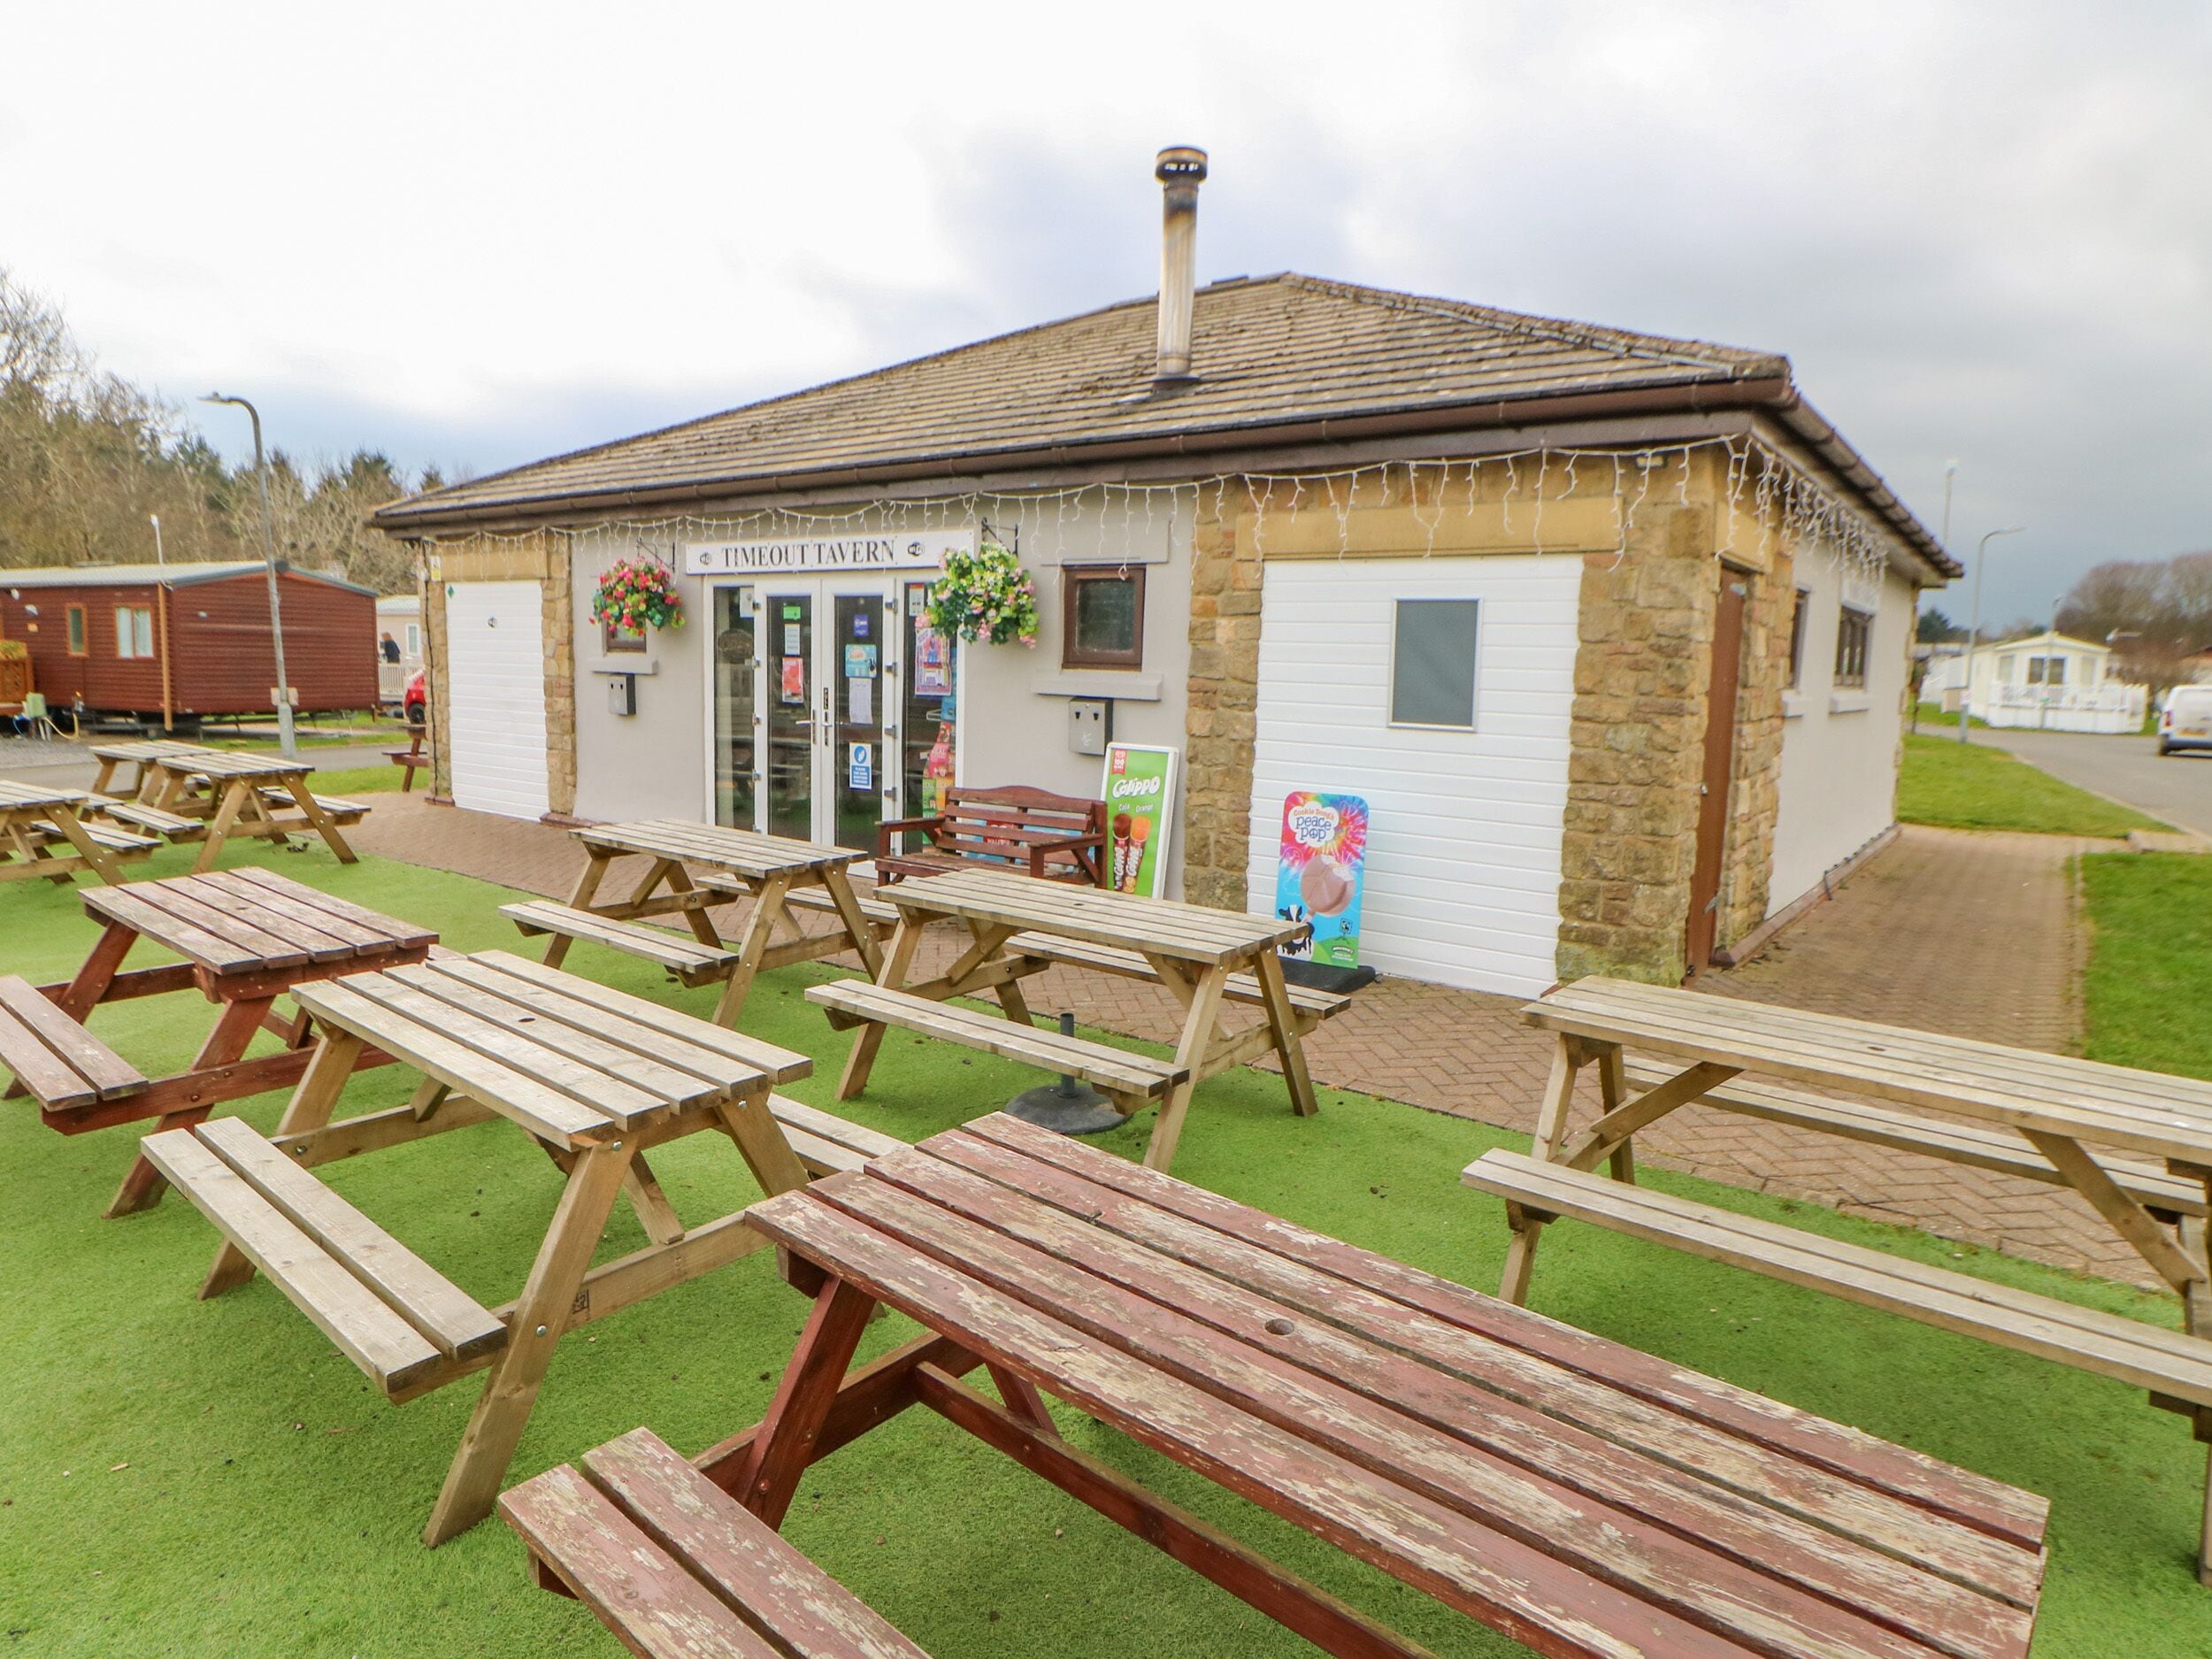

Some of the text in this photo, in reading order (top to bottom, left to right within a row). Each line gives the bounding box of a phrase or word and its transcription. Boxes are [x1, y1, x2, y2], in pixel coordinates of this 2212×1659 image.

[722, 543, 809, 567] TIMEOUT
[813, 540, 895, 565] TAVERN
[1112, 775, 1161, 798] Calippo
[1295, 816, 1332, 831] peace
[1301, 827, 1326, 841] pop
